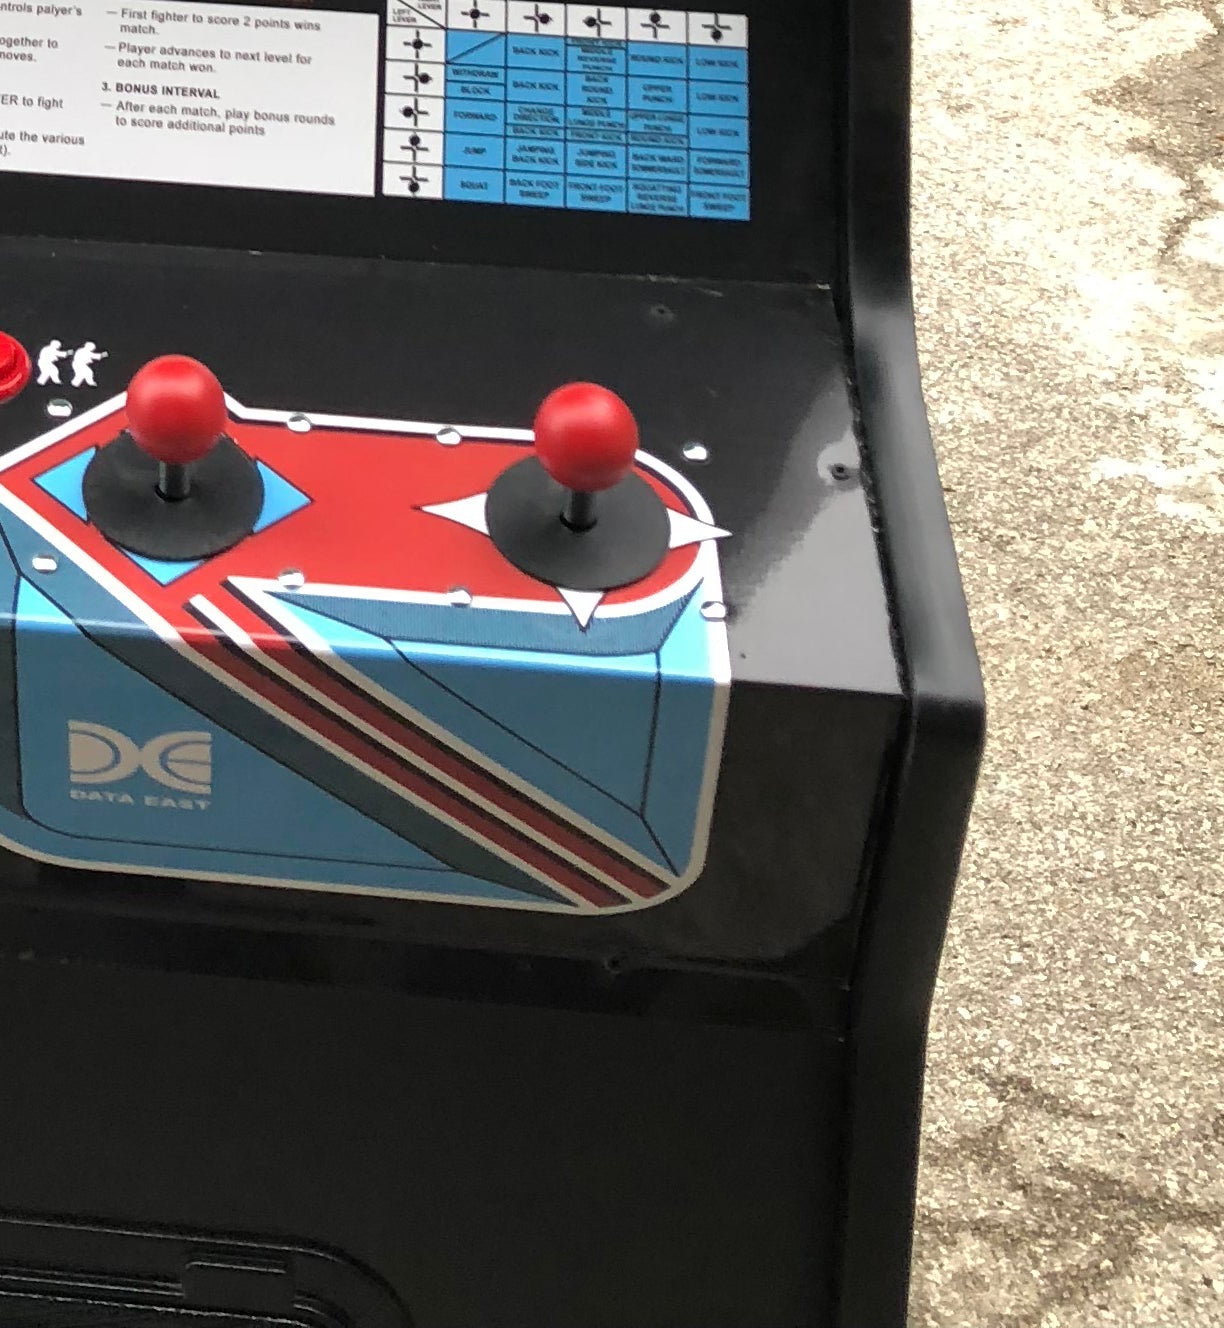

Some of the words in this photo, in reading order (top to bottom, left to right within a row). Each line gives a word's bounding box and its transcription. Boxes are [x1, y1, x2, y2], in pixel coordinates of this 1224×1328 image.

[121, 8, 147, 20] First
[151, 10, 188, 24] fighter
[192, 13, 203, 23] to
[207, 15, 239, 26] score
[244, 16, 250, 27] 2
[255, 17, 290, 29] points
[294, 20, 321, 31] wins
[120, 23, 159, 35] match.
[47, 39, 58, 49] to
[119, 42, 156, 55] Player
[160, 46, 216, 59] advances
[219, 49, 231, 61] to
[235, 52, 260, 62] next
[264, 52, 293, 64] level
[296, 53, 312, 65] for
[117, 58, 146, 68] each
[150, 60, 185, 71] match
[189, 63, 216, 73] won.
[102, 81, 111, 92] 3.
[116, 82, 158, 95] BONUS
[162, 85, 220, 99] INTERVAL
[22, 96, 33, 106] to
[37, 96, 63, 110] fight
[116, 100, 145, 113] After
[149, 104, 177, 115] each
[225, 109, 250, 121] play
[254, 110, 290, 122] bonus
[294, 113, 335, 126] rounds
[116, 116, 127, 127] to
[131, 117, 163, 129] score
[167, 120, 225, 133] additional
[229, 123, 265, 136] points
[19, 131, 38, 142] the
[42, 134, 84, 145] various
[70, 789, 134, 805] DATA
